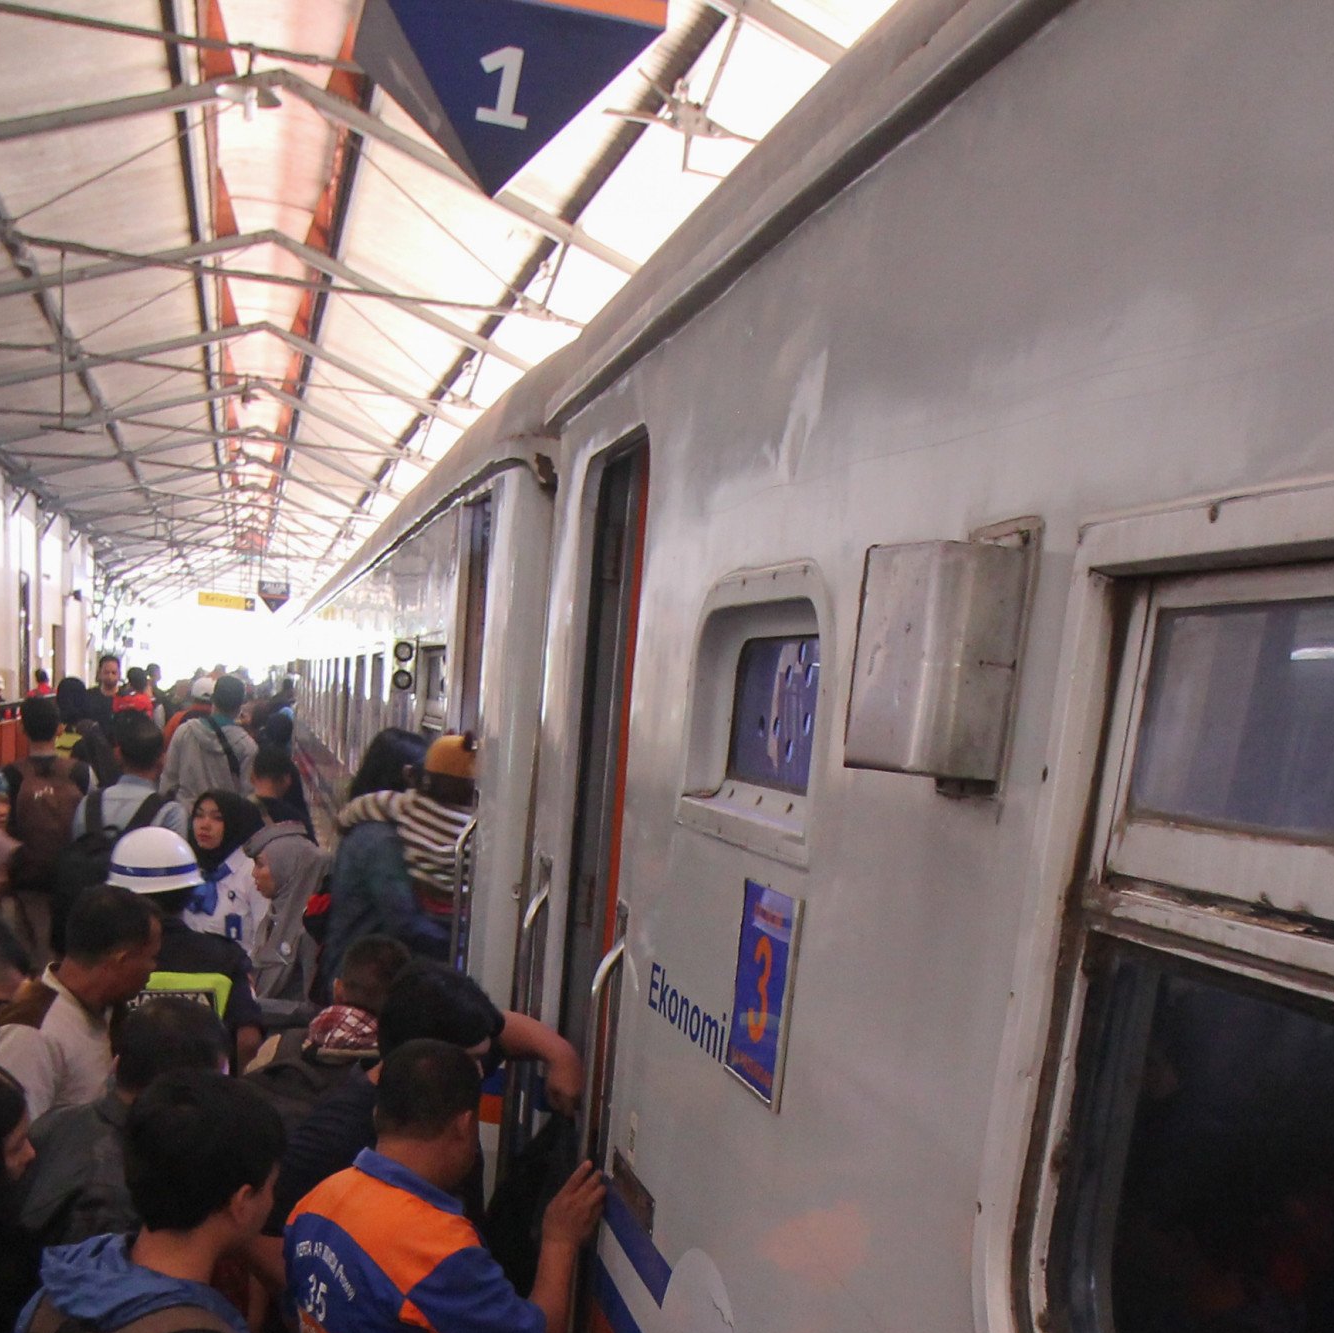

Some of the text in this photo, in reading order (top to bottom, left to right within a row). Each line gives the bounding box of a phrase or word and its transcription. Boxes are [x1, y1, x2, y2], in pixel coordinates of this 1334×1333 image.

[473, 45, 529, 130] 1
[648, 962, 727, 1064] Ekonomi
[747, 935, 773, 1044] 3
[305, 1274, 327, 1322] 35
